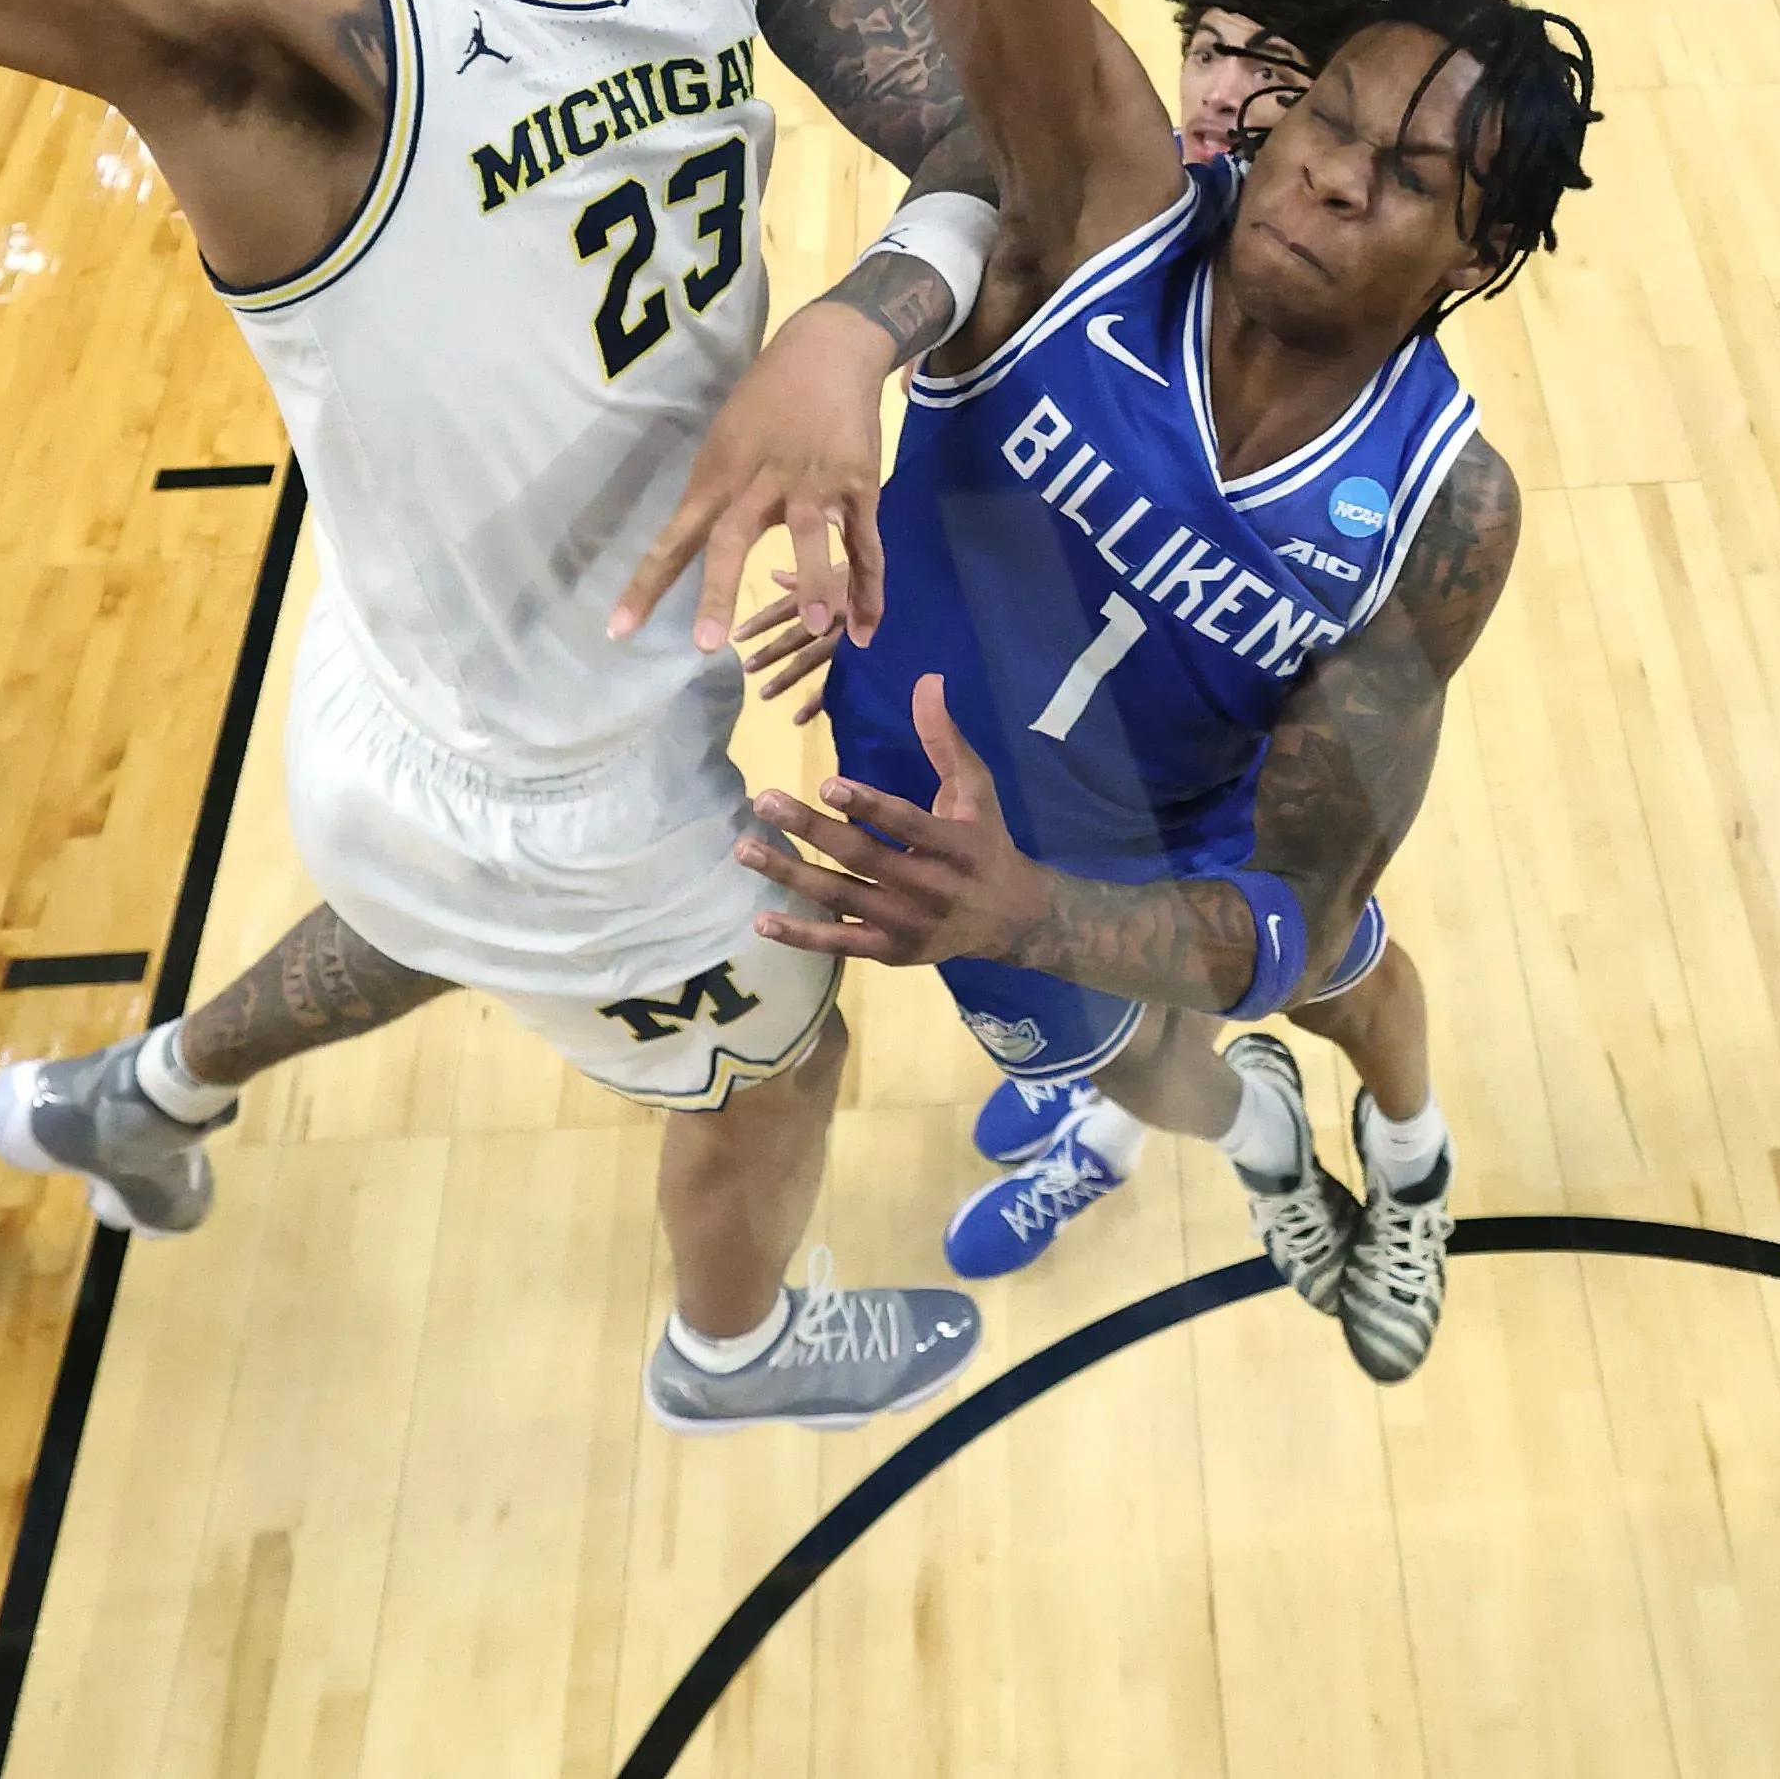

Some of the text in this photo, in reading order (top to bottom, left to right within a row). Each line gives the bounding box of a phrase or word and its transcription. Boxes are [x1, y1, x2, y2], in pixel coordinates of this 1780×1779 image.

[569, 132, 748, 388] 23
[1333, 499, 1385, 530] NCAA
[1273, 536, 1362, 582] A10
[1027, 590, 1148, 742] 1
[595, 958, 764, 1044] M
